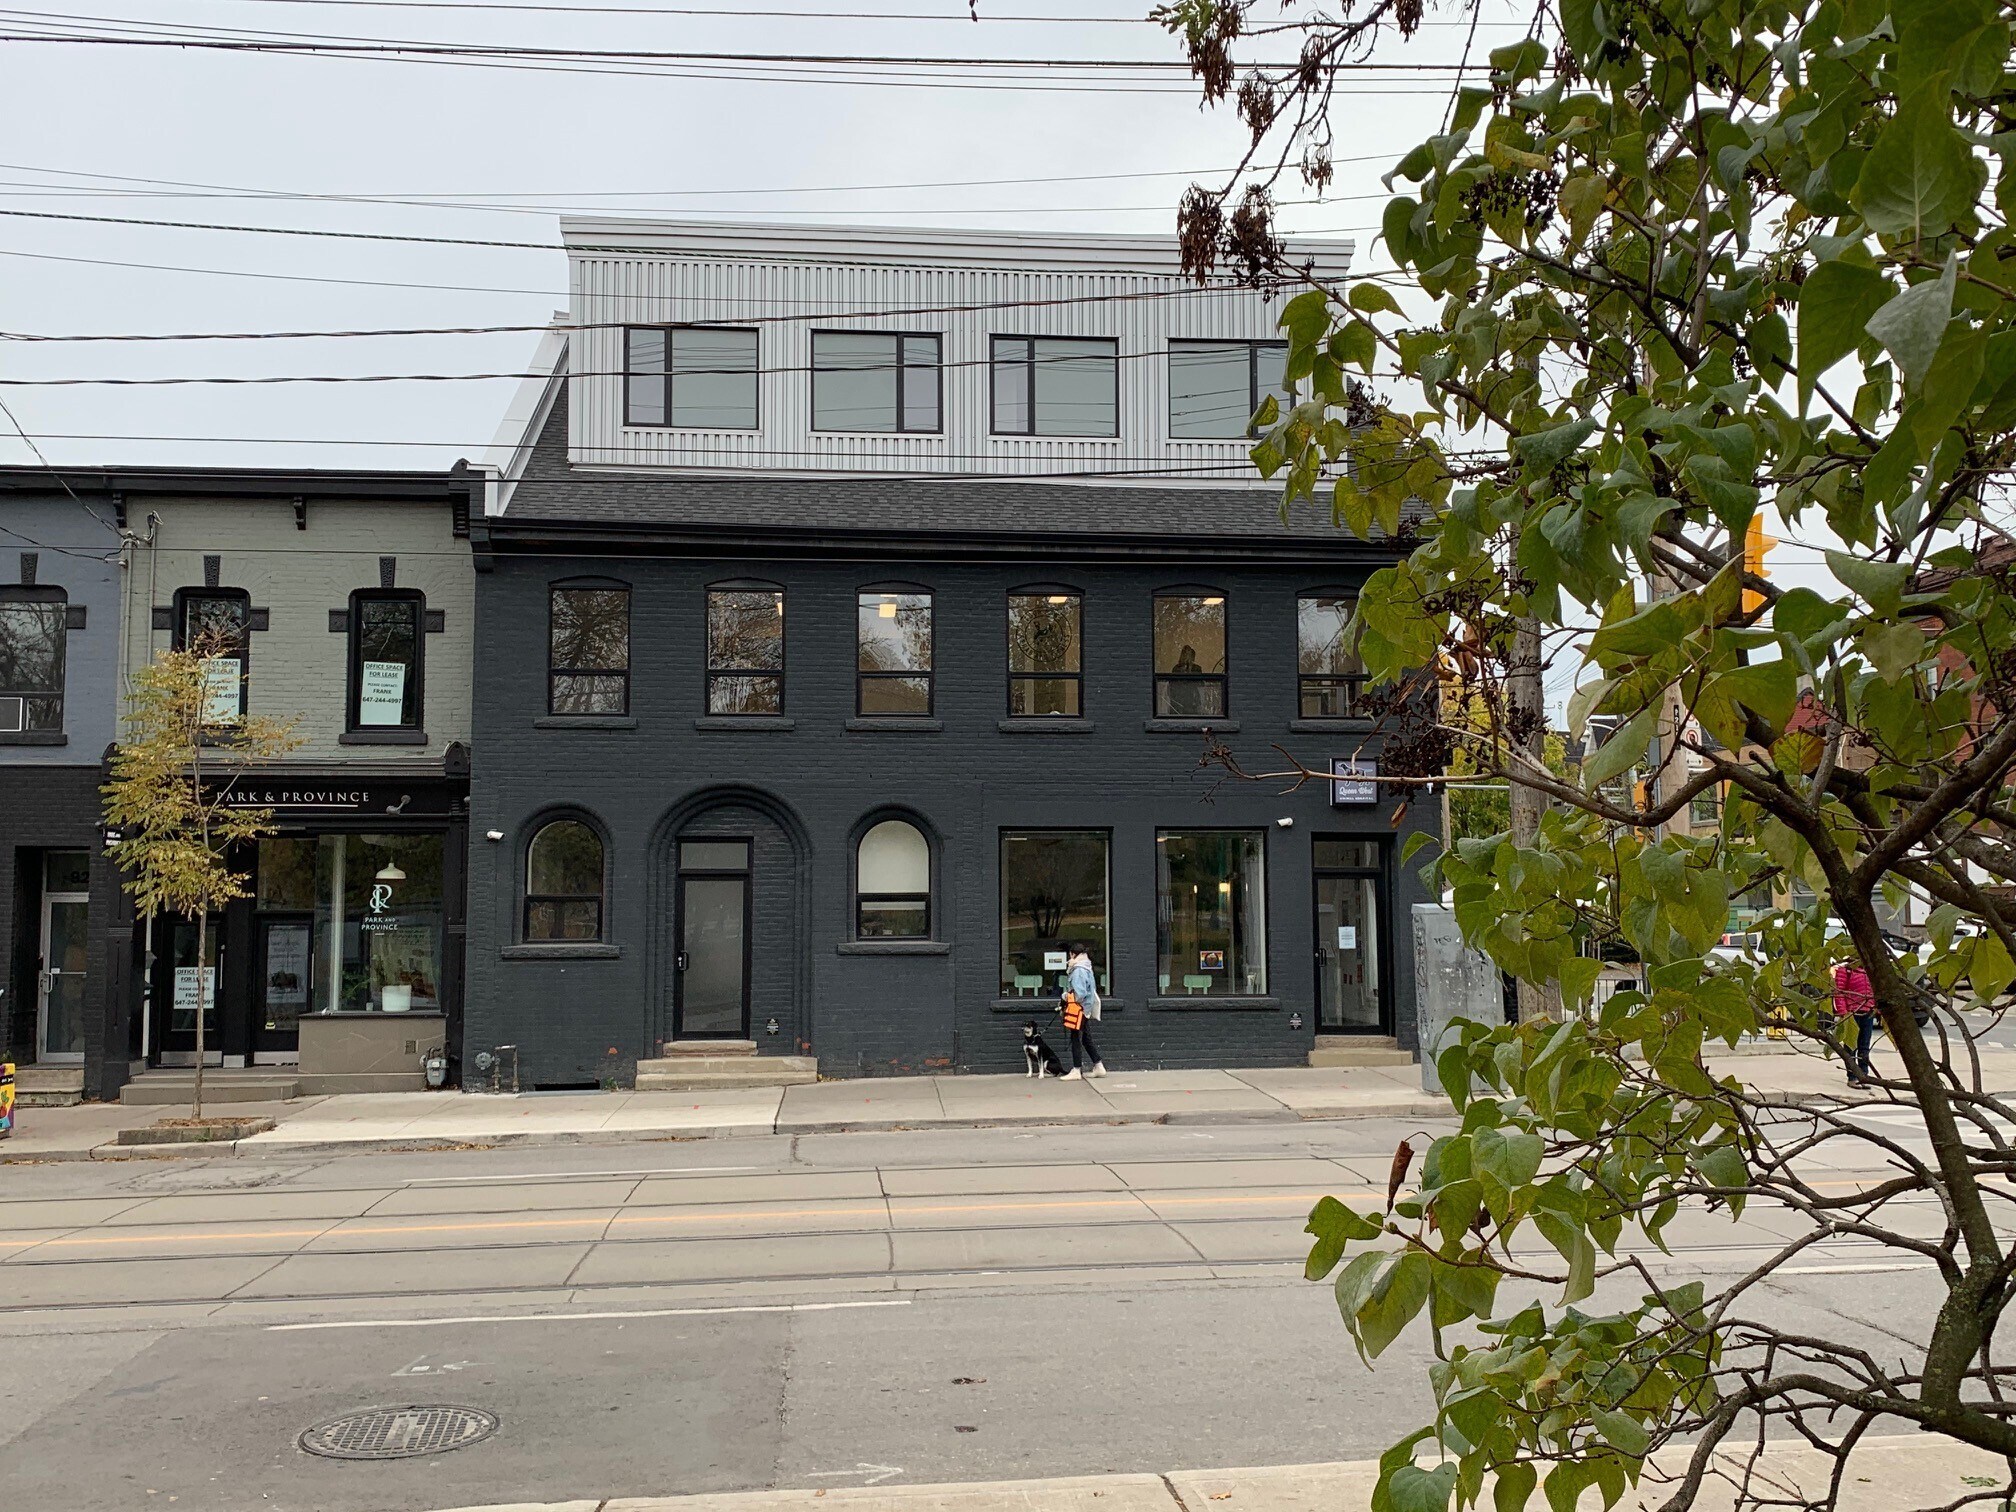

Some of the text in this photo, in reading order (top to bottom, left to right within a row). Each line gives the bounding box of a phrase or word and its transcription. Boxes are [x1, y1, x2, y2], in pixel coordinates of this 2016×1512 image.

[1339, 786, 1357, 796] Queen
[216, 791, 370, 802] PARK & PROVINCE
